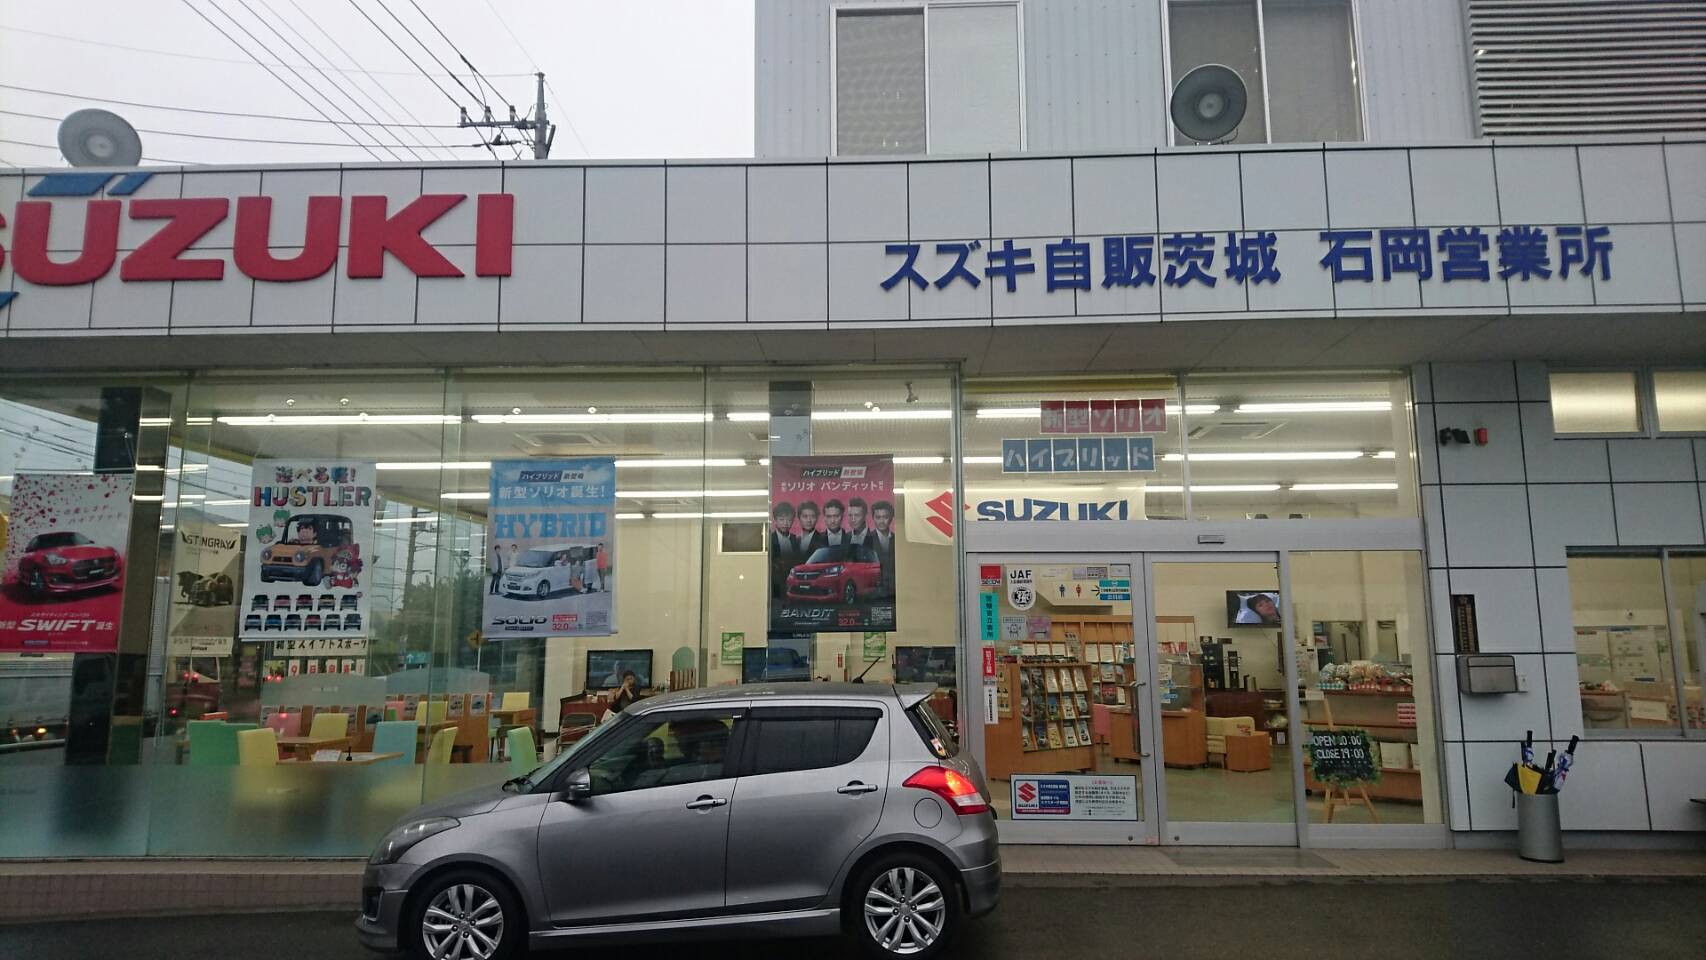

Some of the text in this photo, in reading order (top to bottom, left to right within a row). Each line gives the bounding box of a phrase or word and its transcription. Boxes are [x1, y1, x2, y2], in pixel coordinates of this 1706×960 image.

[0, 193, 515, 286] UZUKI
[880, 224, 1613, 293] スズキ自販茨城 石岡営業所
[1042, 407, 1164, 428] 新型ソリオ
[1004, 447, 1150, 467] ハイブリッド
[254, 485, 372, 508] HUSTLER
[977, 498, 1128, 522] SUZUKI
[494, 512, 607, 538] HYBRID
[185, 534, 237, 550] STINGRAY
[1009, 569, 1032, 580] JAF
[780, 608, 834, 619] BANDIT
[17, 618, 97, 632] SWIFT
[1313, 735, 1336, 746] OPEN
[1316, 748, 1365, 759] CLOSE 19:00
